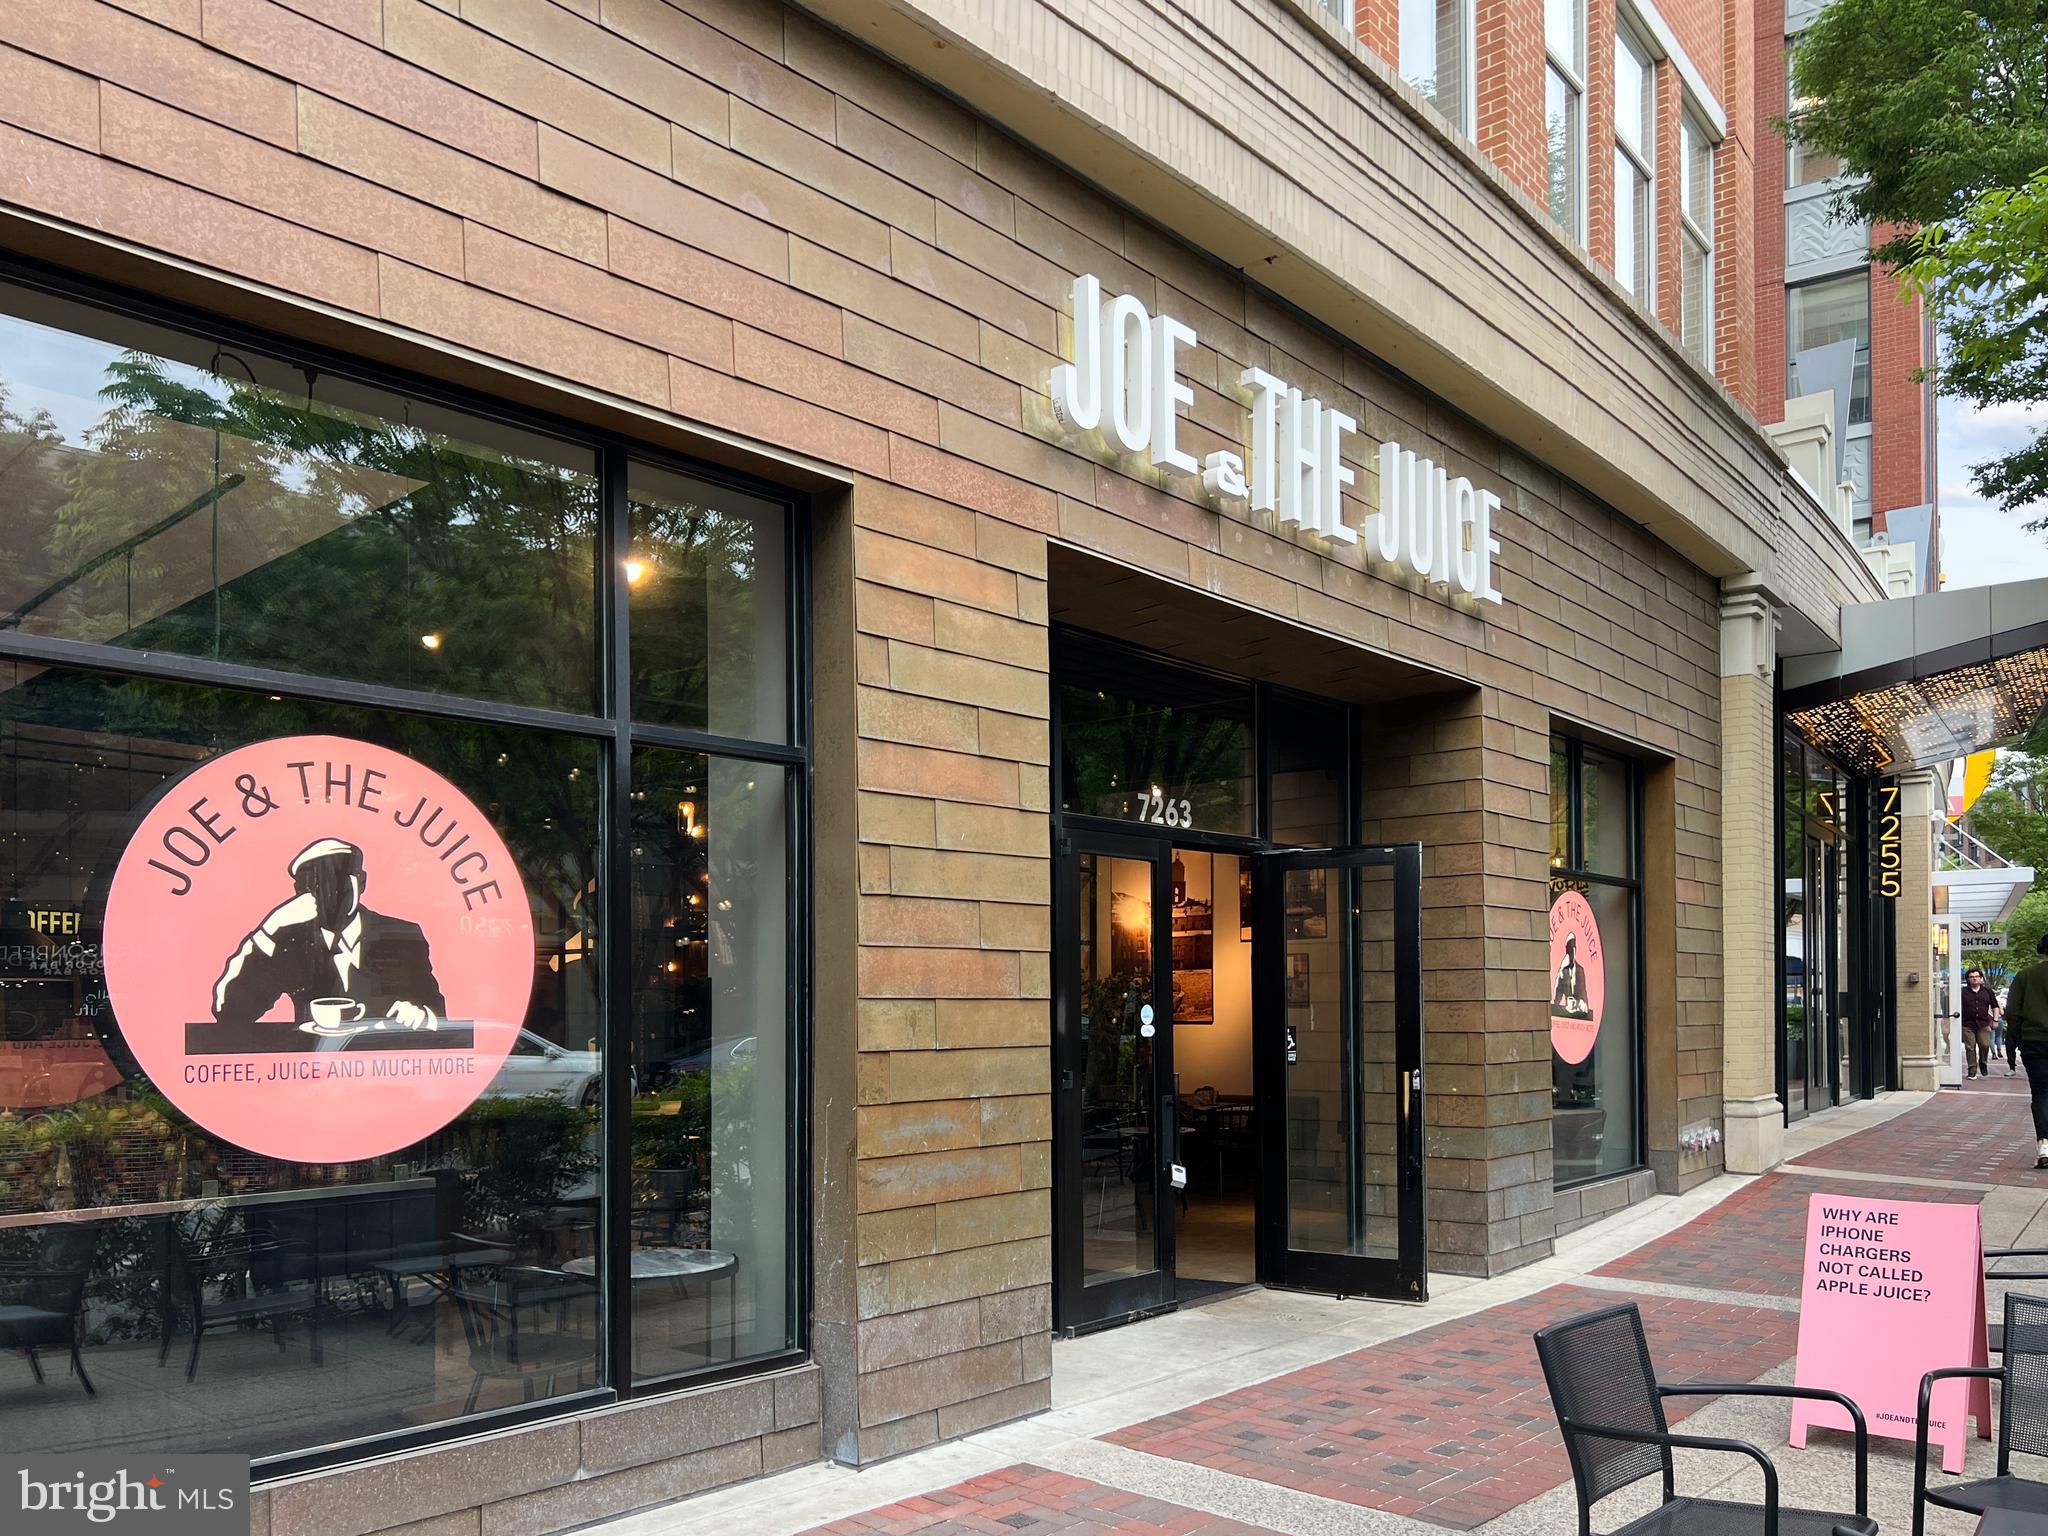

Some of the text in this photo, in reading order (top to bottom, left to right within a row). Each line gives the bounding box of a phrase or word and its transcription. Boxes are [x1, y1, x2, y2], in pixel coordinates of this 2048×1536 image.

[1051, 273, 1503, 606] JOE & THE JUICE
[1137, 792, 1193, 829] 7263
[148, 761, 503, 913] JOE & THE JUICE
[1880, 787, 1900, 897] 7255
[1566, 901, 1581, 921] THE
[1581, 916, 1598, 962] JUICE
[1975, 937, 1999, 946] TACO
[184, 1057, 476, 1085] COFFEE, JUICE AND MUCH MORE
[1822, 1207, 1899, 1226] WHY ARE
[1821, 1225, 1884, 1242] IPHONE
[1819, 1243, 1911, 1263] CHARGERS
[1818, 1261, 1923, 1283] NOT CALLED
[1816, 1279, 1931, 1302] APPLE JUICE?
